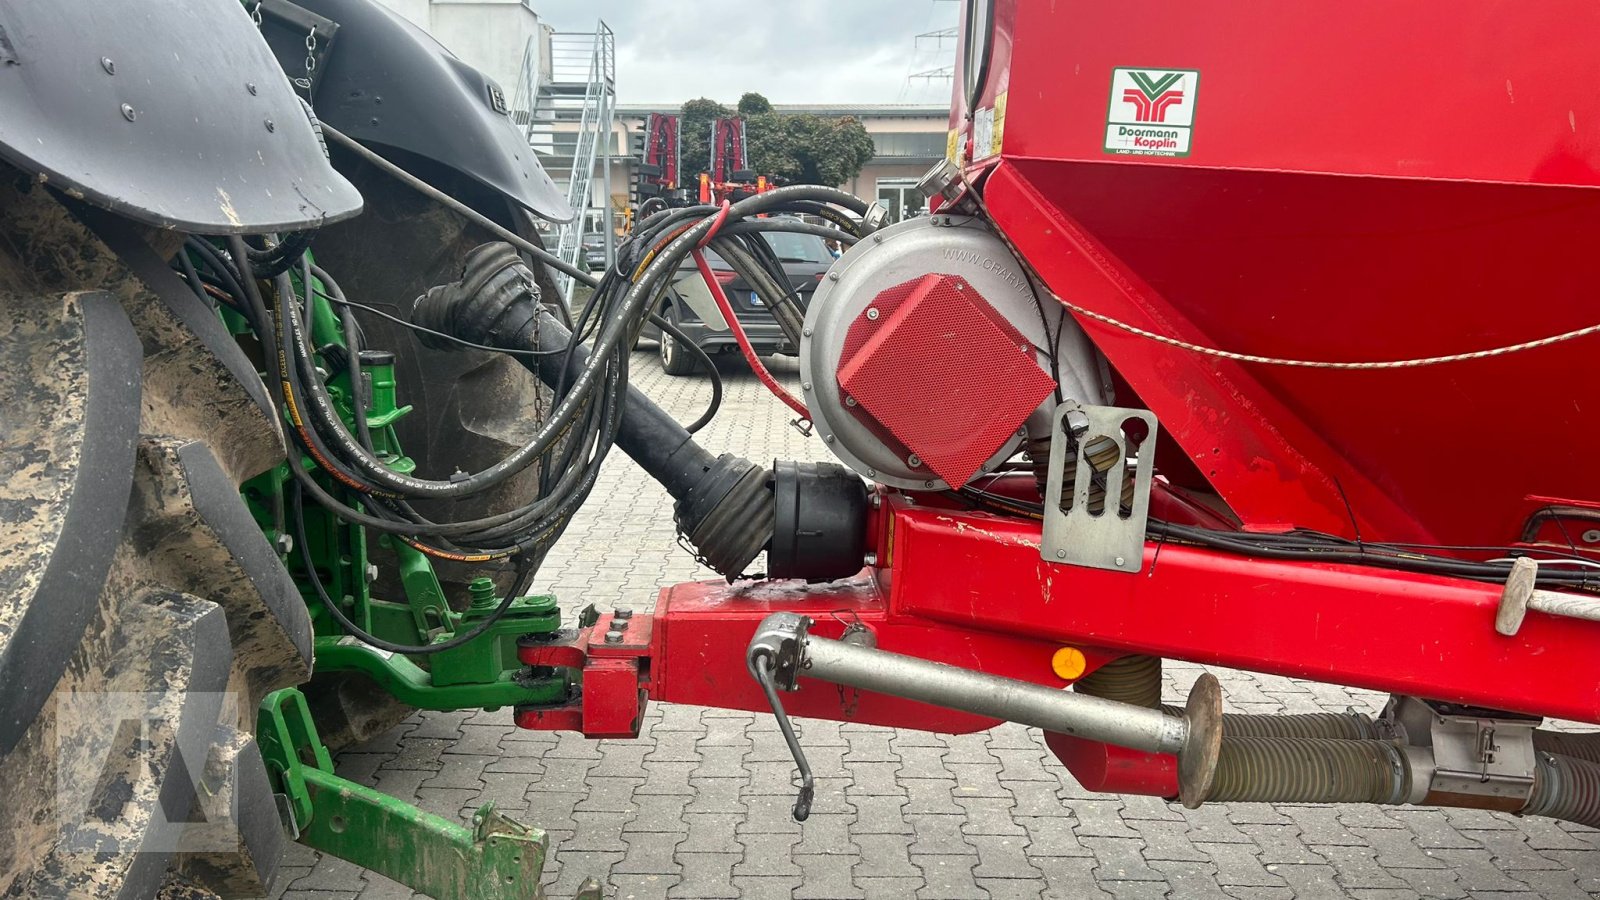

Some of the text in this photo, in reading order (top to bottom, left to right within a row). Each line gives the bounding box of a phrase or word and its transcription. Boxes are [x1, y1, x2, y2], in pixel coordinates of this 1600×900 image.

[1118, 126, 1178, 139] Doormann
[1134, 136, 1176, 150] Kopplin
[278, 349, 288, 378] EXCEEDS
[589, 343, 606, 369] HANSA-FLEX
